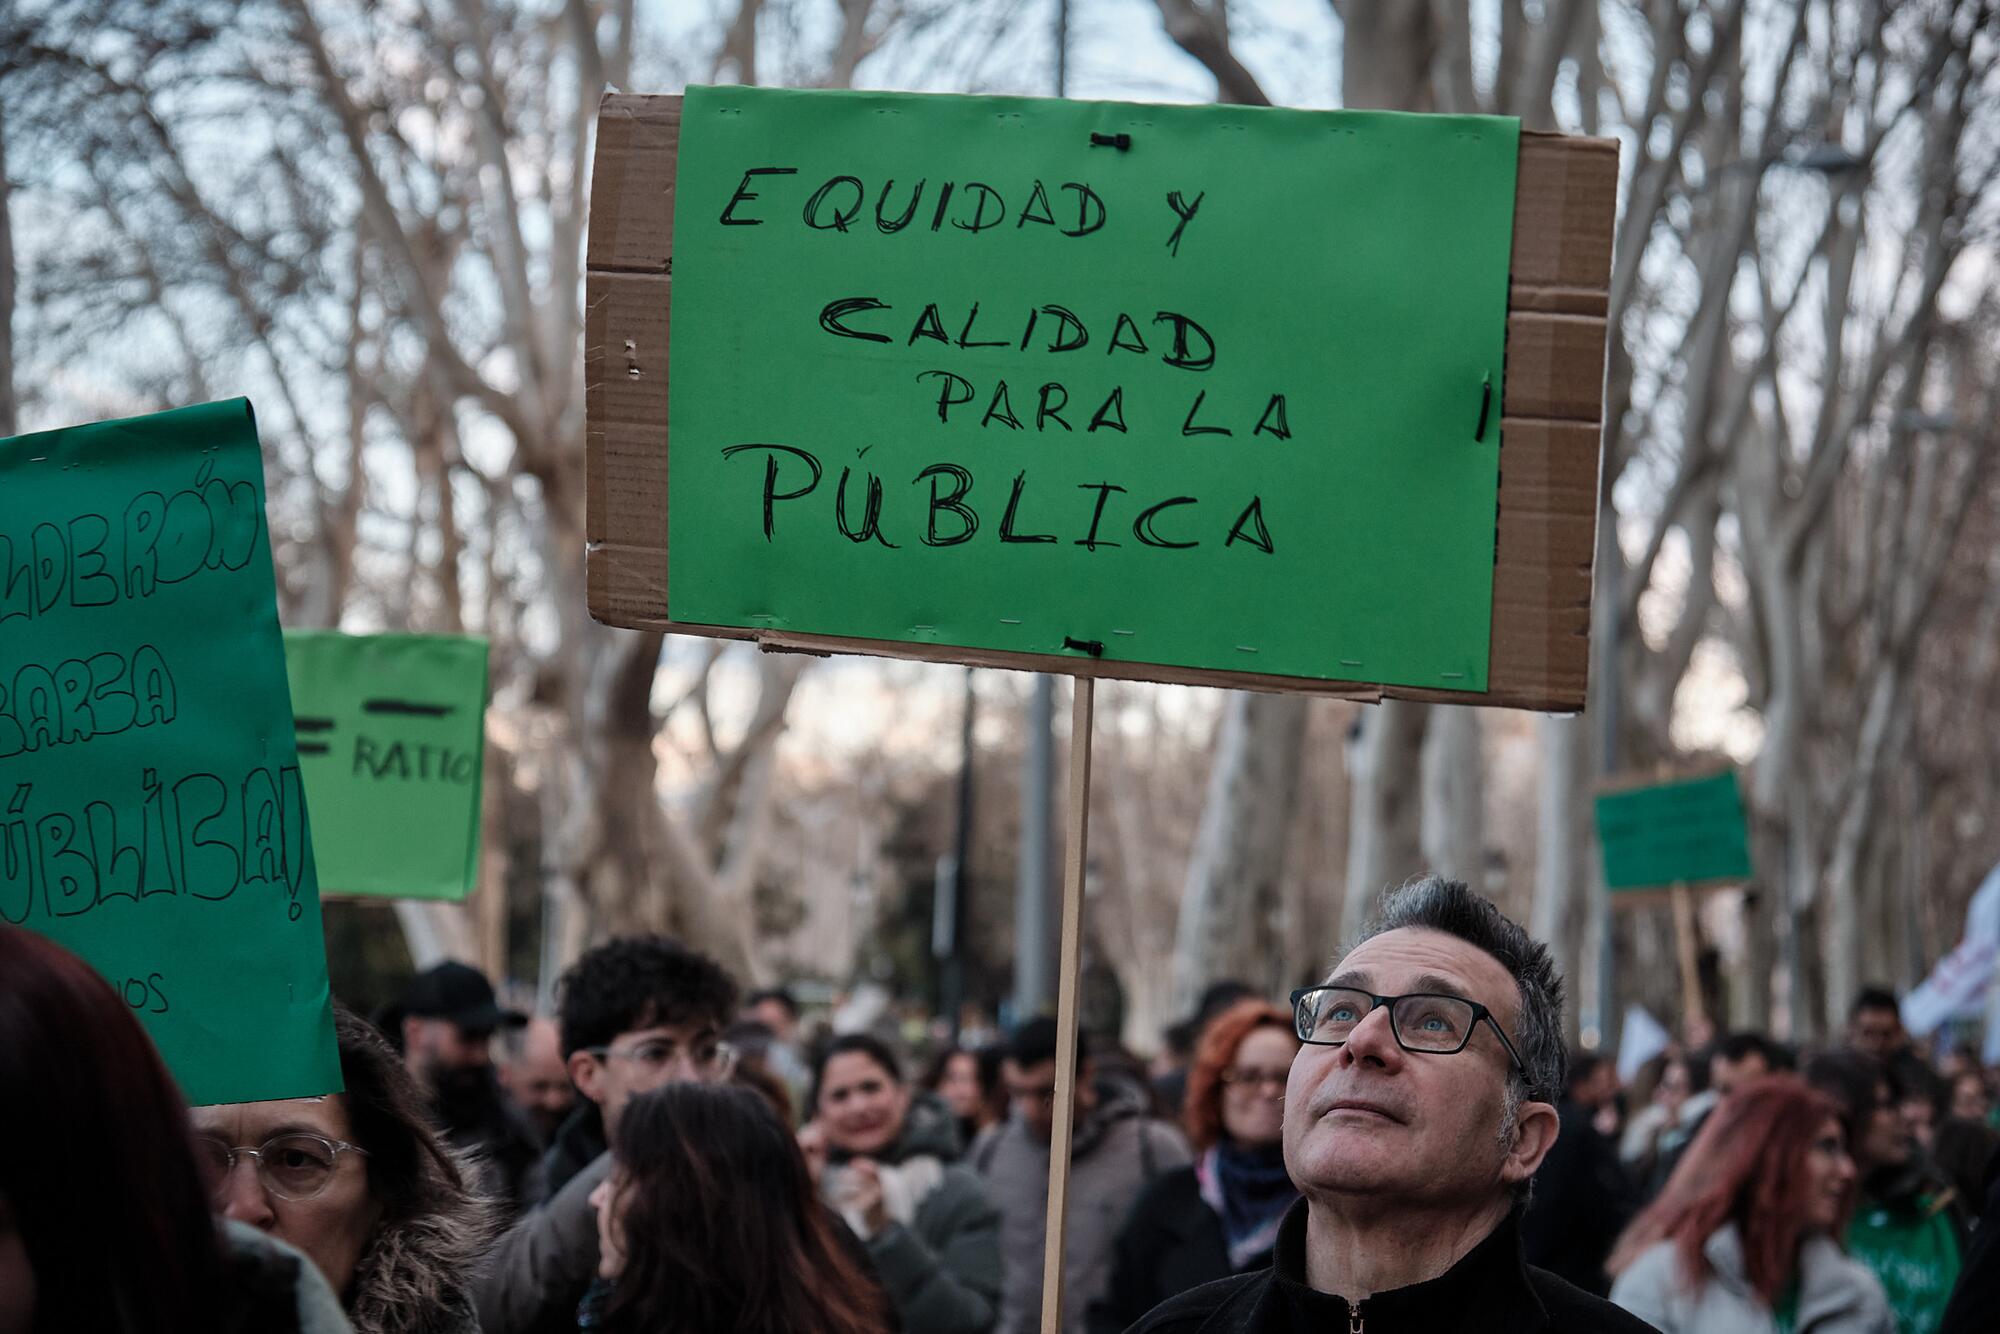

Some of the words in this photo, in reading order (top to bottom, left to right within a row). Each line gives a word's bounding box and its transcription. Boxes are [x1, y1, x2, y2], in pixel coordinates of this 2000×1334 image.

[720, 167, 1107, 238] EQUIDAD
[1166, 191, 1205, 258] Y
[819, 297, 1216, 371] CALIDAD
[916, 370, 1129, 434] PARA
[1182, 390, 1293, 441] LA
[721, 444, 1275, 554] PÚBLICA
